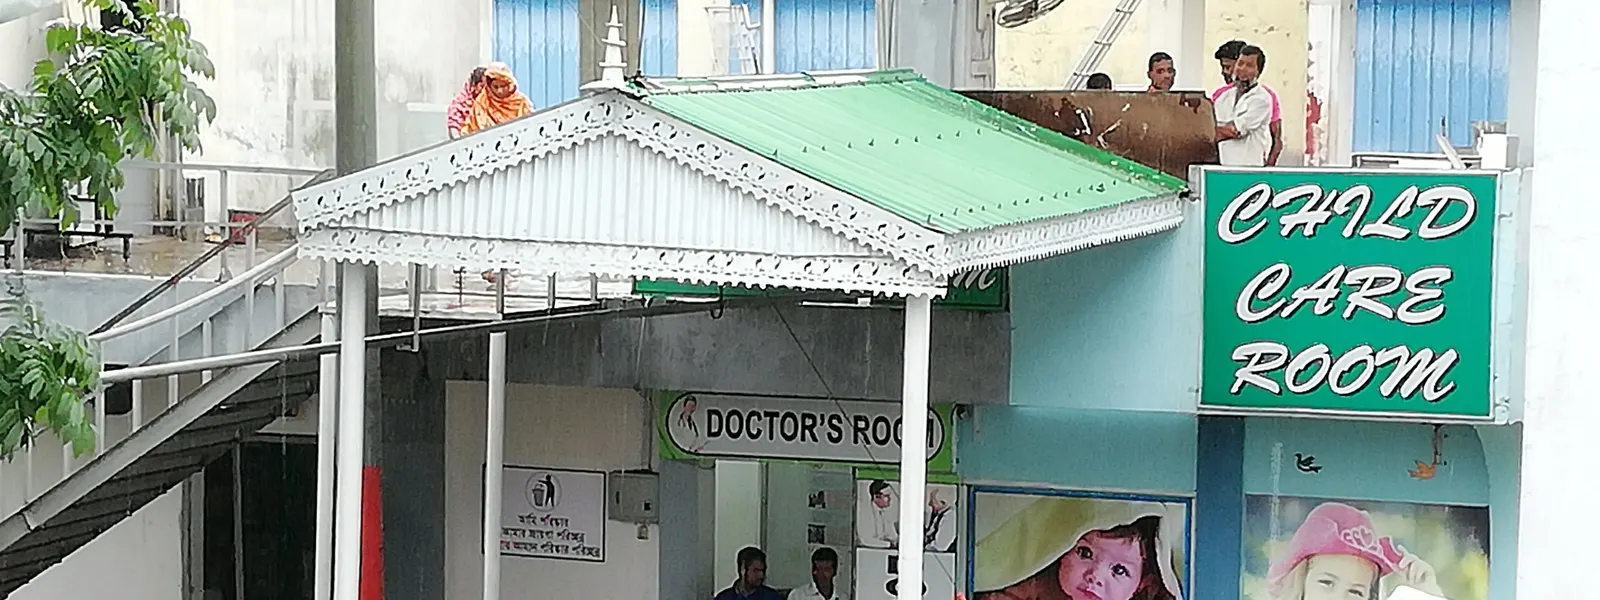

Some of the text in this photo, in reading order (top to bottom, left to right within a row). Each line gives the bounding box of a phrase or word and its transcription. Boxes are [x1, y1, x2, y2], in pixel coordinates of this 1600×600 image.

[1217, 182, 1478, 244] CHILD
[1235, 262, 1454, 325] CARE
[1230, 341, 1460, 403] ROOM
[706, 408, 844, 444] DOCTOR'S
